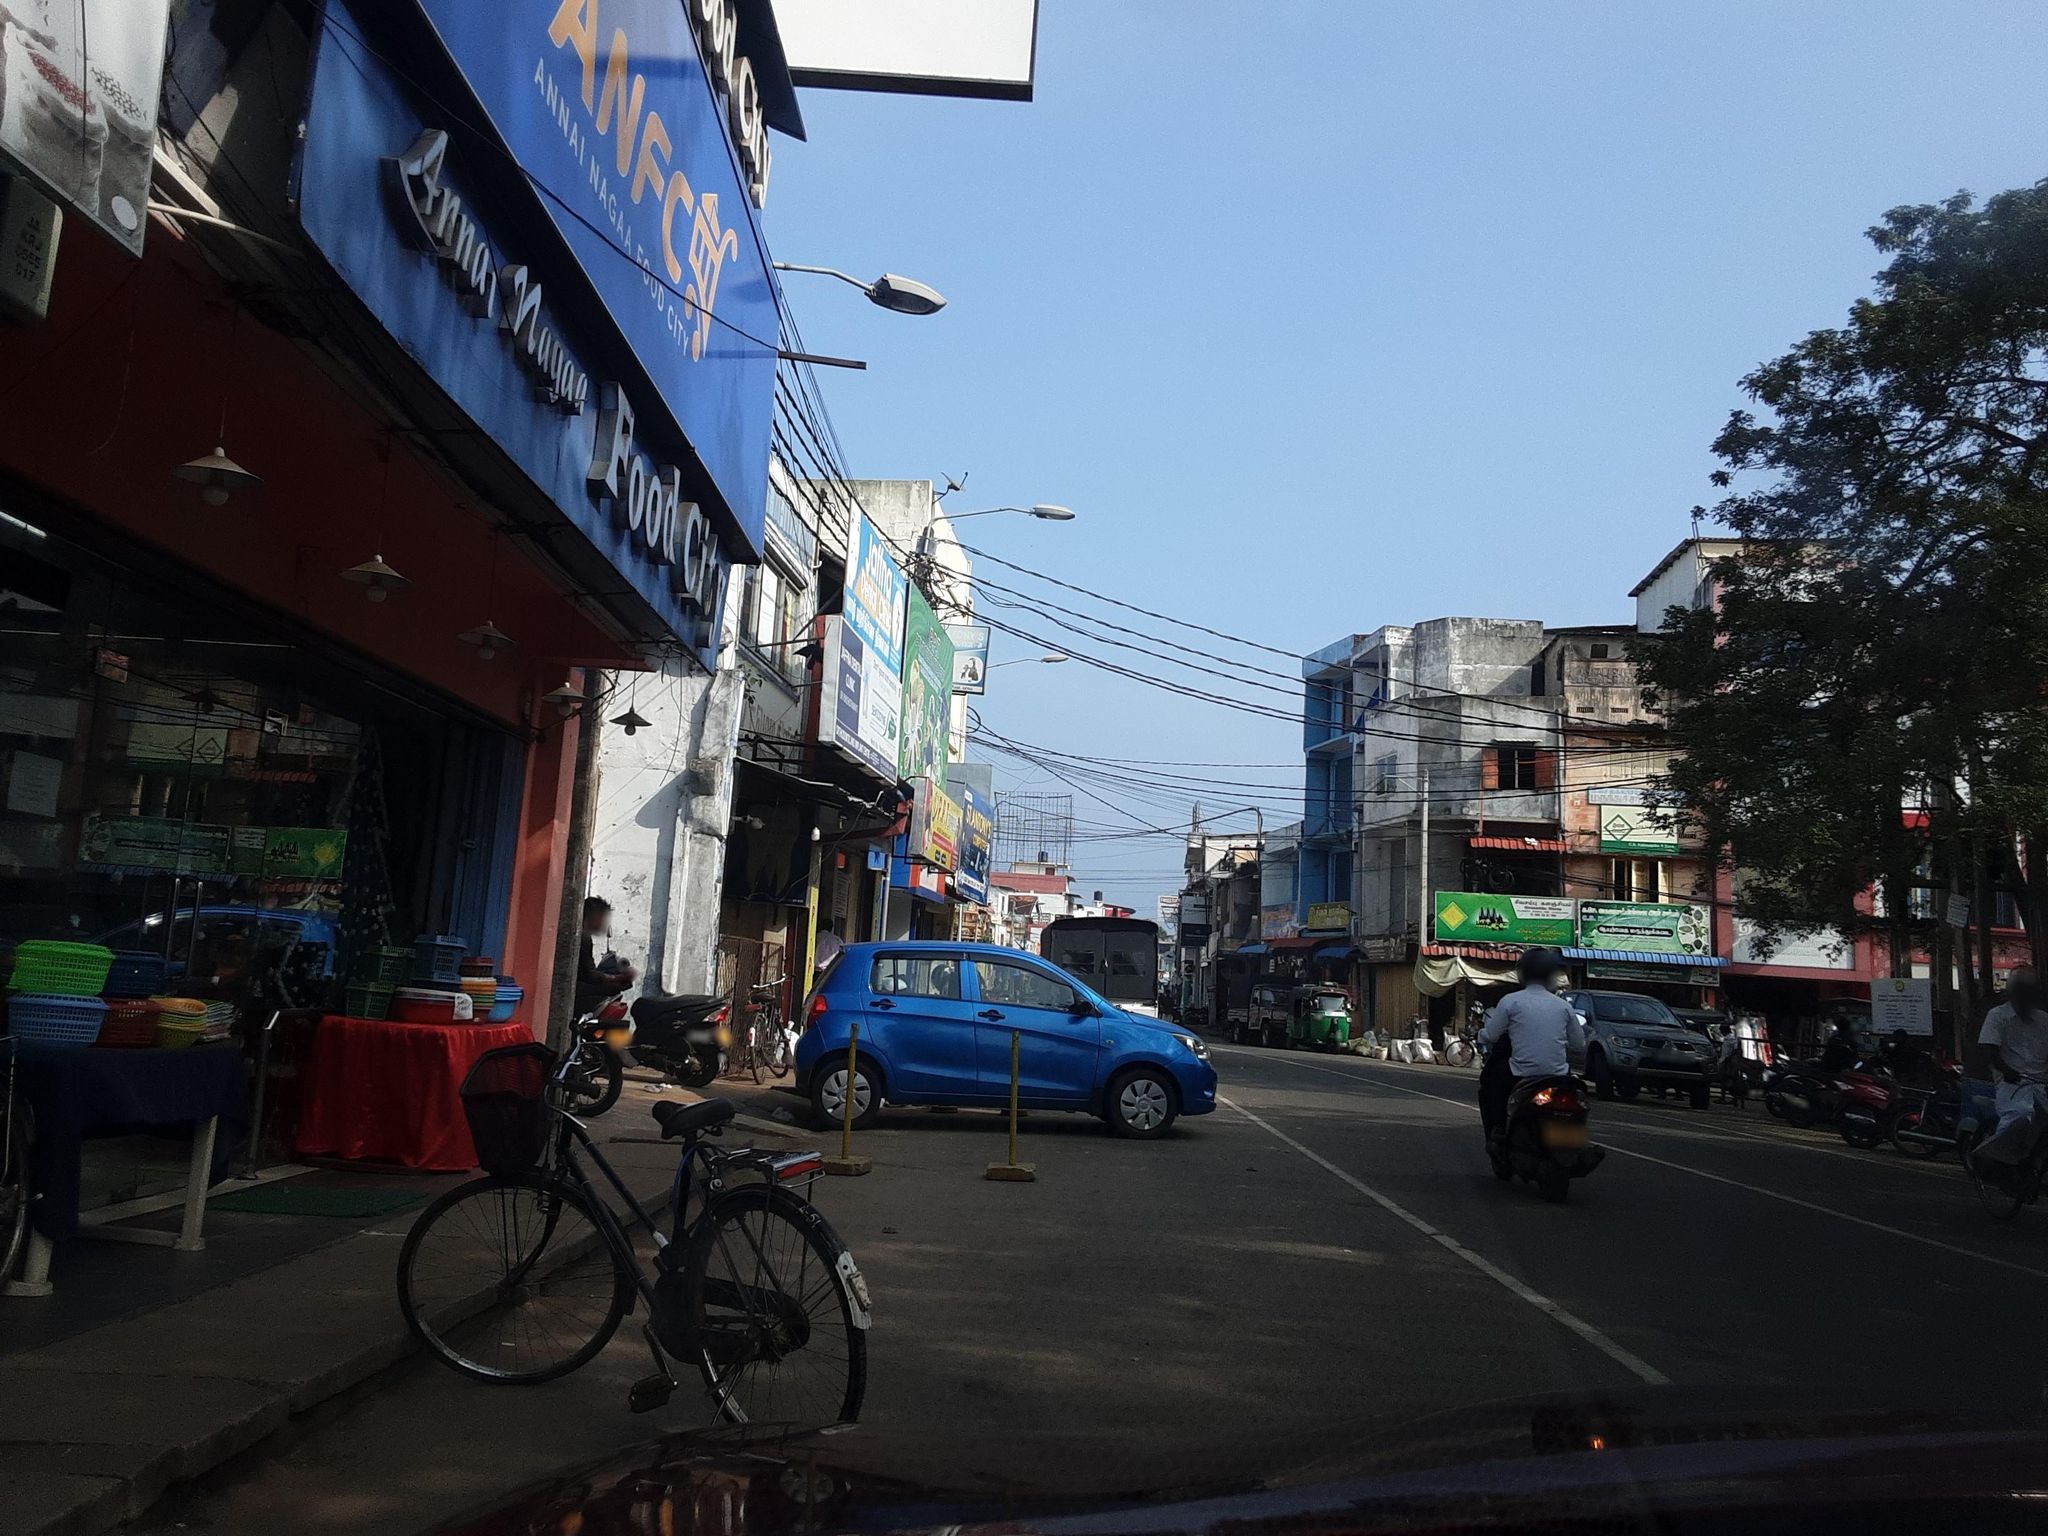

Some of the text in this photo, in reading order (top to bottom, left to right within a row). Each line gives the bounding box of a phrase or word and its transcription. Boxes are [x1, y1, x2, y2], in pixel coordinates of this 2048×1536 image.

[534, 57, 690, 356] ANNAI NAGAA FOOD CITY
[603, 379, 681, 565] Food
[865, 533, 893, 602] Jaffna
